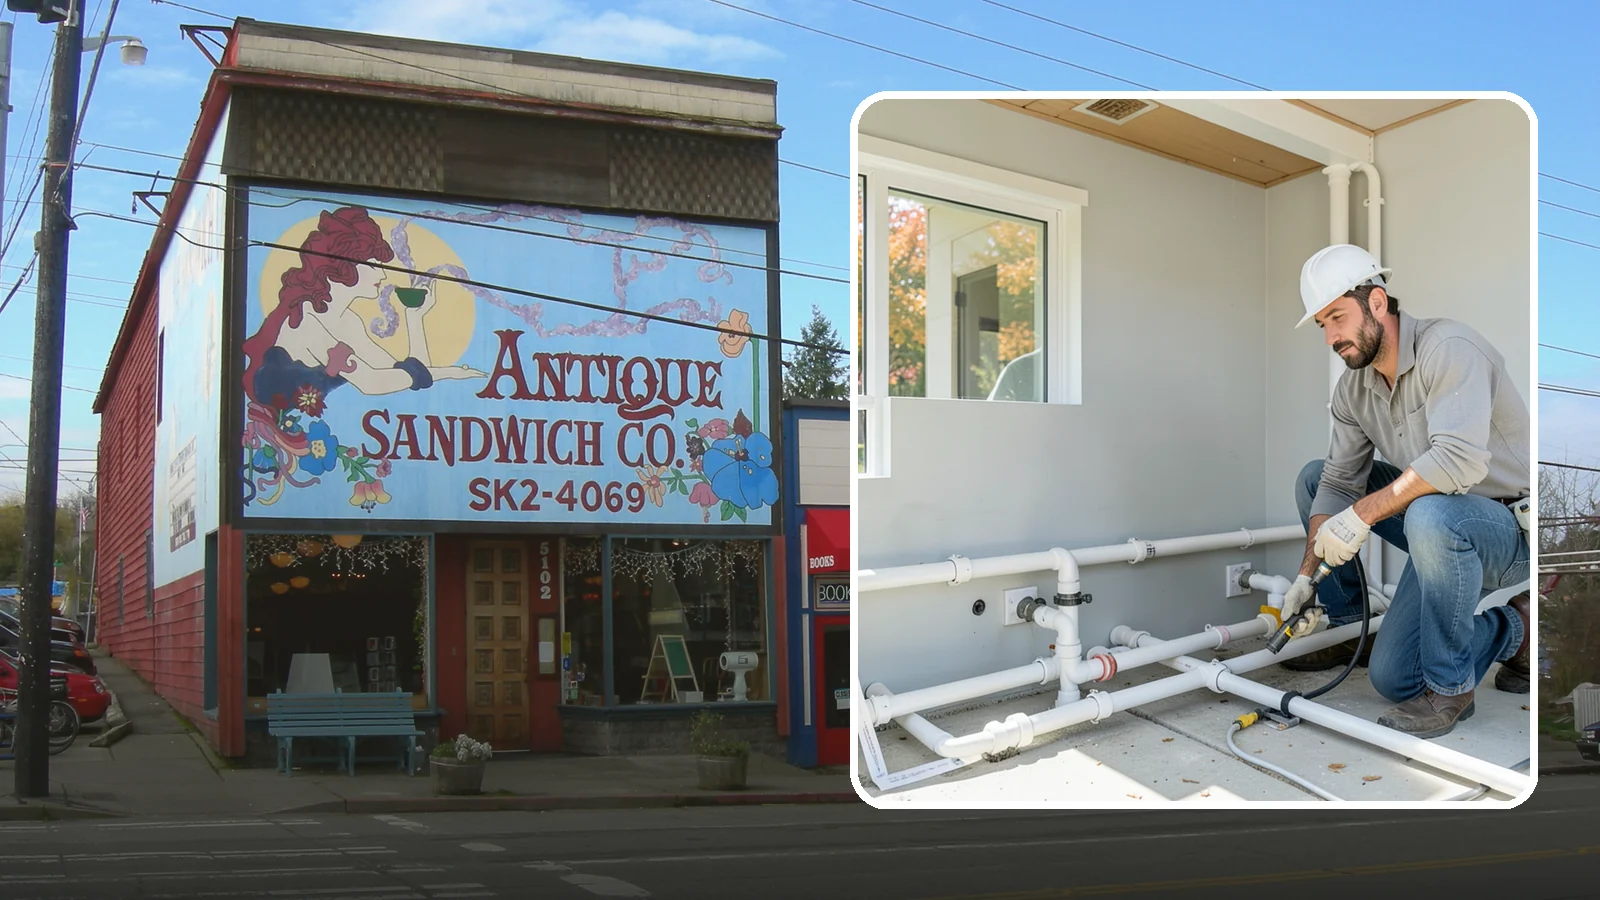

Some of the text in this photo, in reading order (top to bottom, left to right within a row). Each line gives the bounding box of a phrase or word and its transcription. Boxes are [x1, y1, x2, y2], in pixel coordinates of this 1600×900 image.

[475, 329, 724, 420] ANTIQUE
[361, 408, 685, 469] SANDWICH CO.
[467, 477, 646, 513] SK2-4069
[539, 541, 552, 599] 5102
[809, 555, 835, 569] BOOKS
